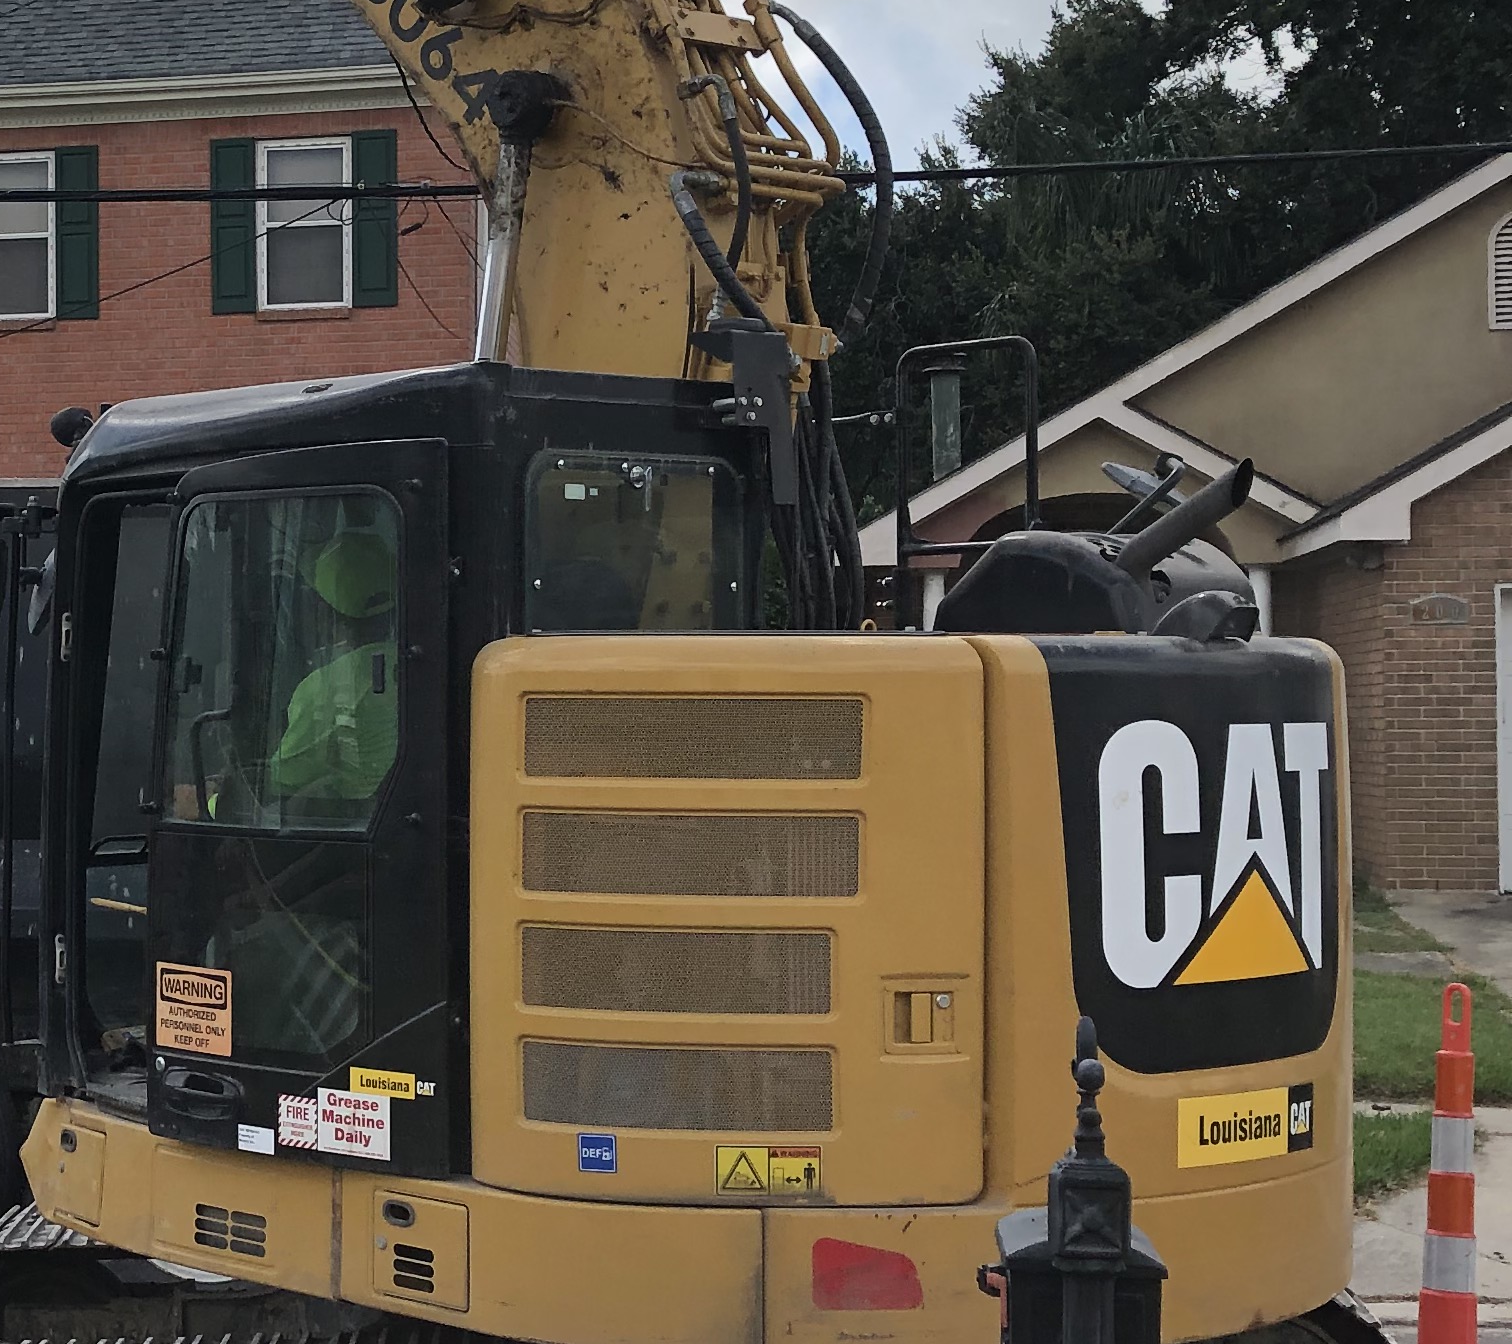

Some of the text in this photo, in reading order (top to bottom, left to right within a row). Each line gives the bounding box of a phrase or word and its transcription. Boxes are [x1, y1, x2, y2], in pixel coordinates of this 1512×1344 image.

[1098, 719, 1329, 989] CAT
[164, 977, 224, 1001] WARNING
[168, 1005, 217, 1022] AUTHORIZED
[160, 1017, 227, 1037] PERSONNEL ONLY
[174, 1034, 210, 1048] KEEP OFF
[359, 1074, 437, 1097] Louisiana CAT
[326, 1092, 380, 1112] Grease
[286, 1104, 310, 1121] FIRE
[321, 1108, 385, 1130] Machine
[1199, 1100, 1312, 1146] Louisiana CAT
[334, 1127, 372, 1148] Daily
[581, 1147, 602, 1159] DEF
